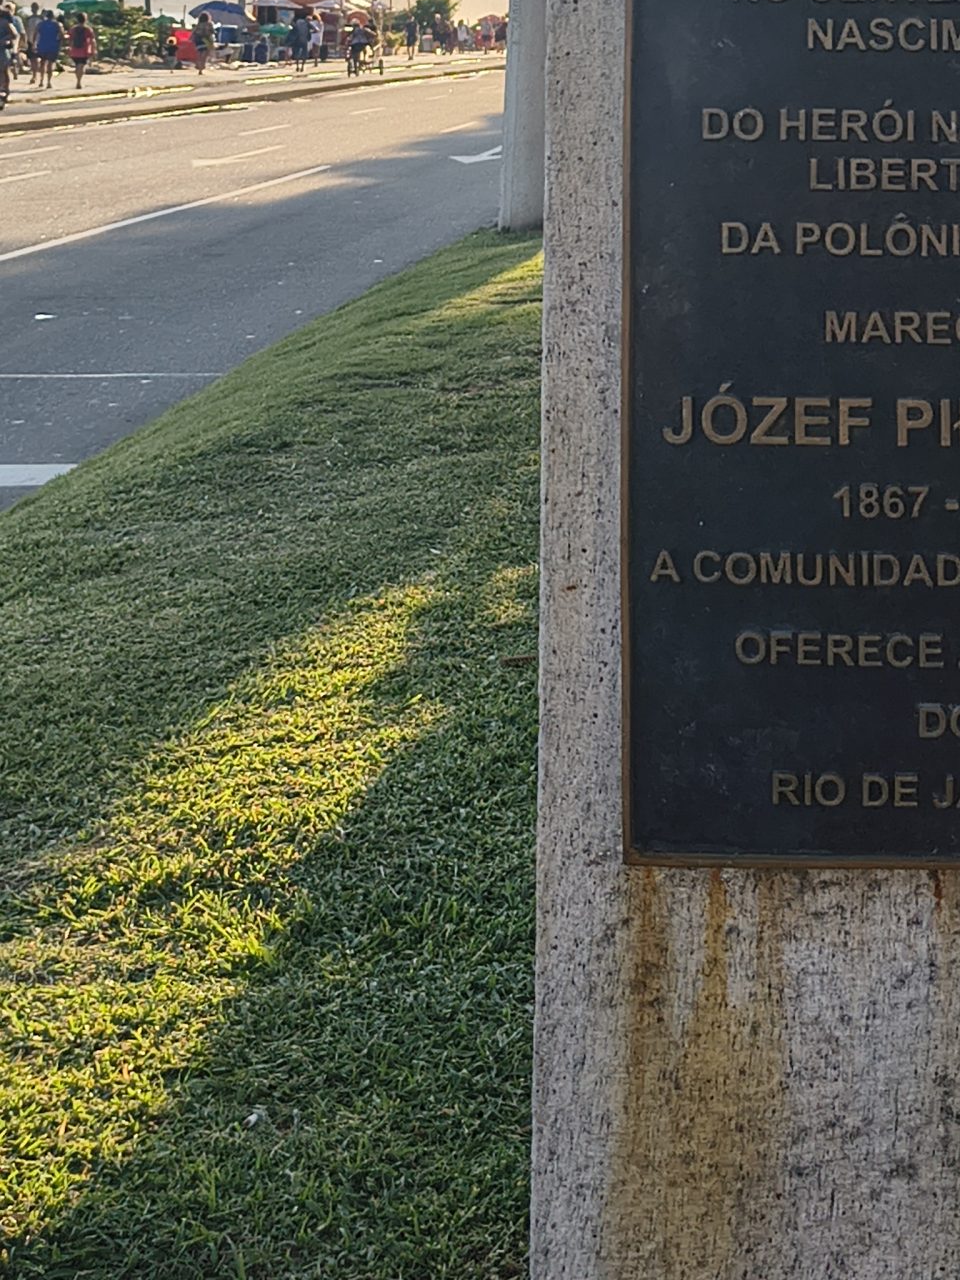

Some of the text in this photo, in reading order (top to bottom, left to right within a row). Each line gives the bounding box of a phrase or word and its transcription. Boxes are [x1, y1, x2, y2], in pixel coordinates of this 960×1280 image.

[702, 107, 764, 141] DO
[780, 99, 915, 142] HERÓI
[721, 221, 781, 255] DA
[662, 381, 873, 446] JÓZEF
[832, 483, 929, 519] 1867
[945, 498, 959, 511] -
[650, 549, 681, 583] A
[734, 631, 945, 669] OFERECE
[772, 771, 846, 807] RIO
[862, 772, 919, 807] DE
